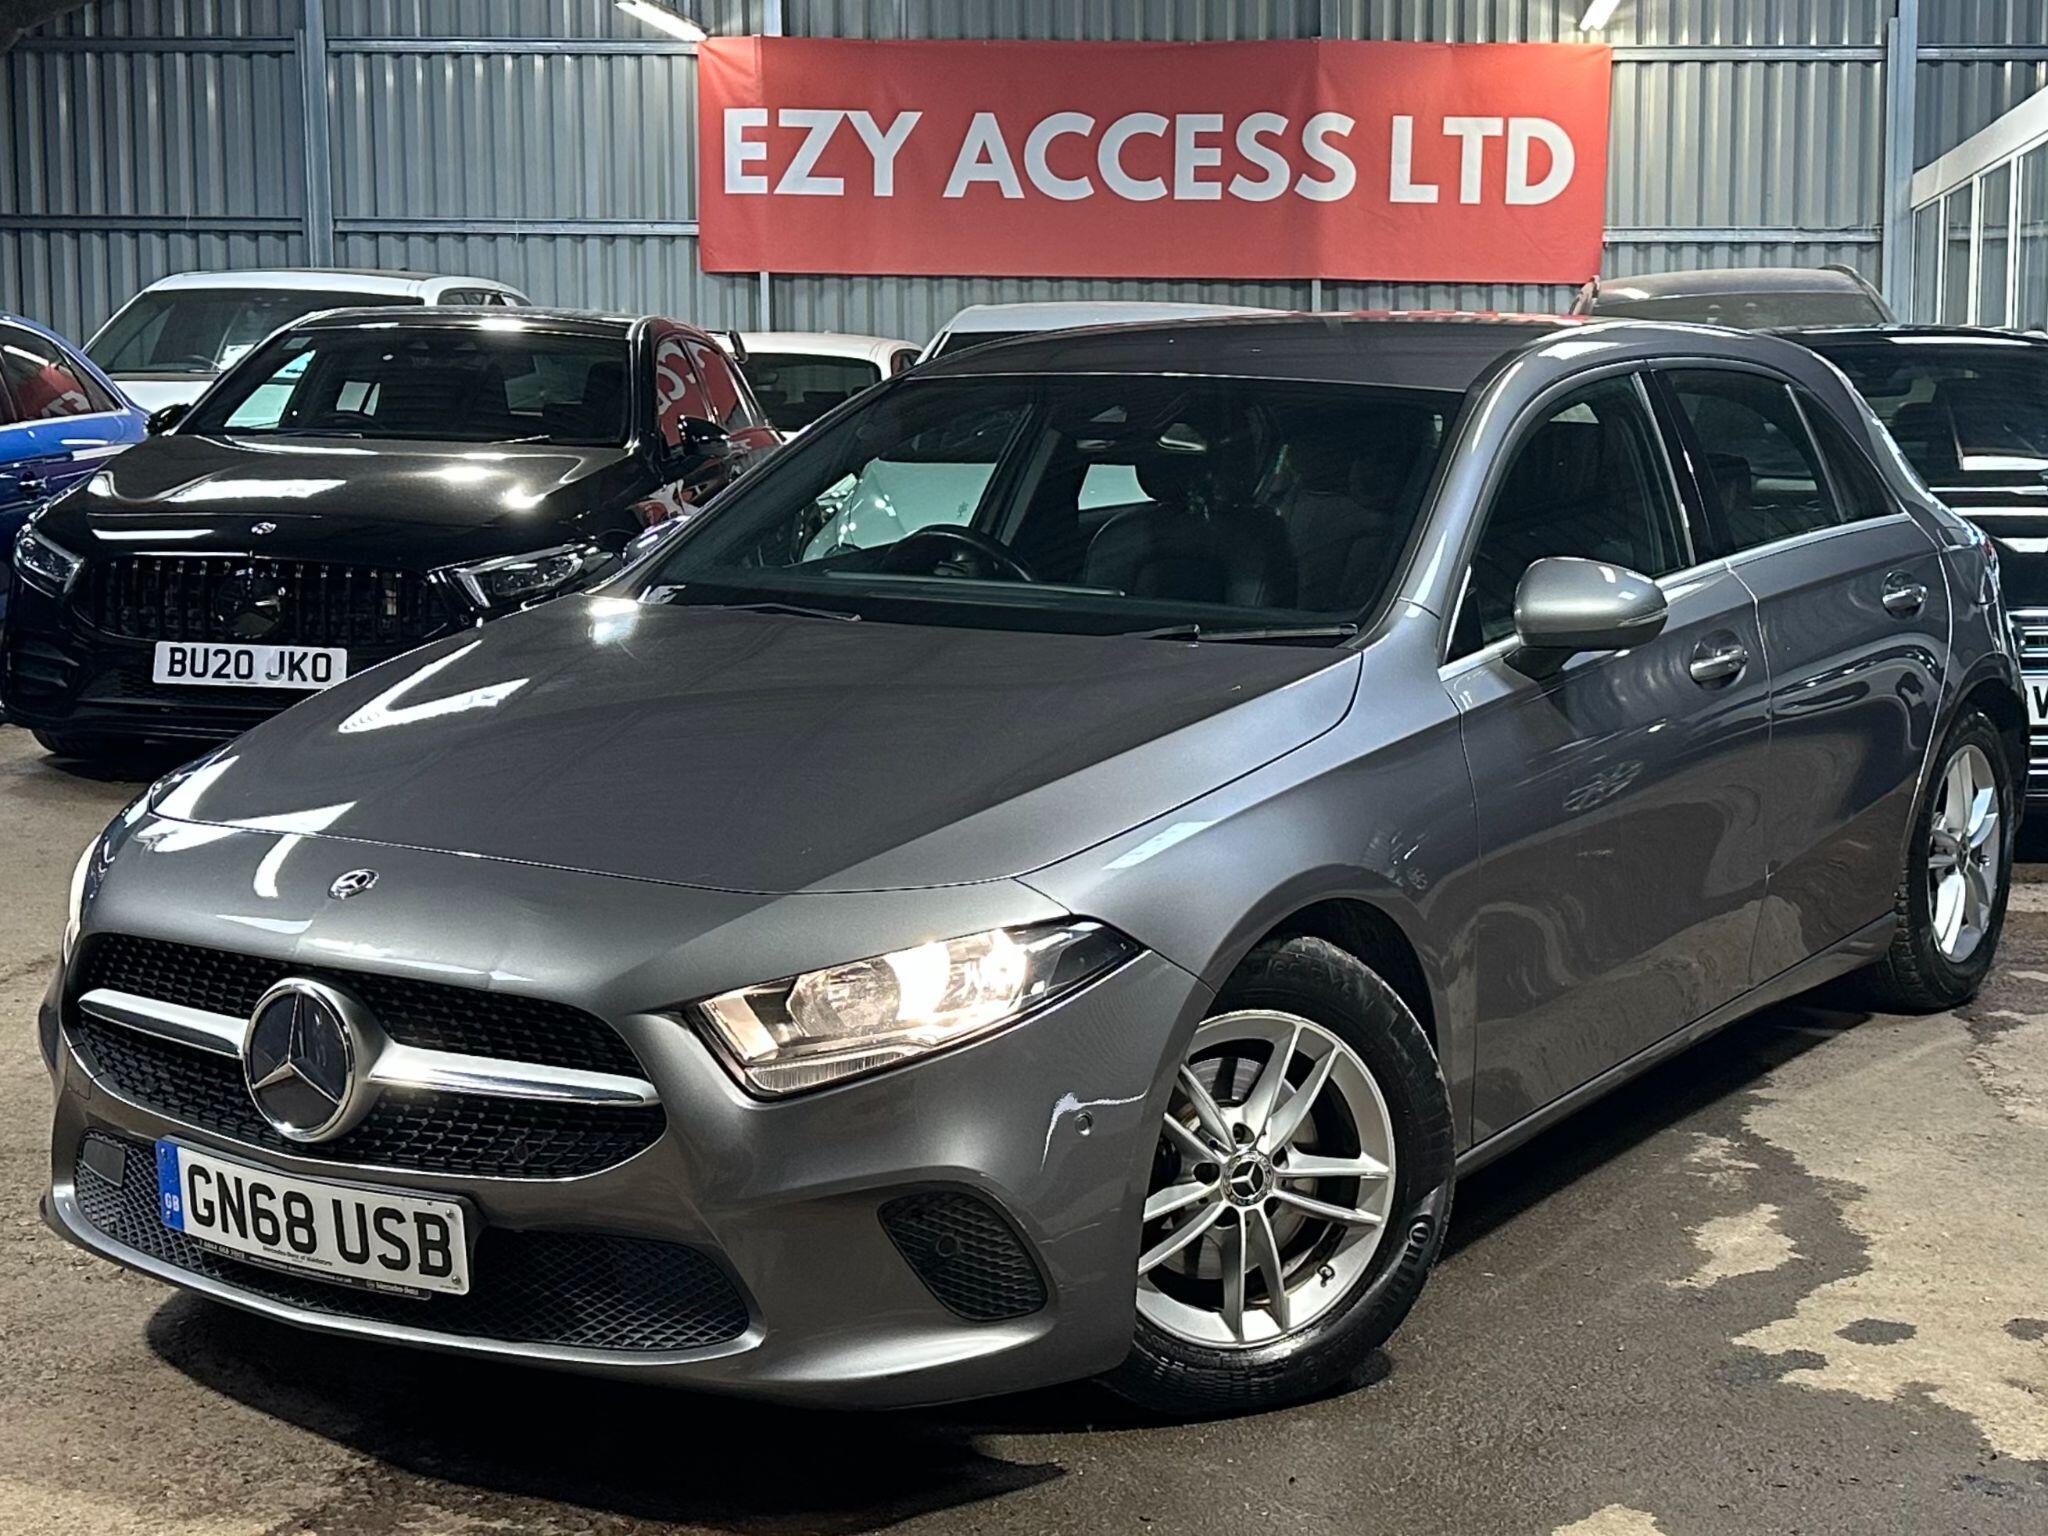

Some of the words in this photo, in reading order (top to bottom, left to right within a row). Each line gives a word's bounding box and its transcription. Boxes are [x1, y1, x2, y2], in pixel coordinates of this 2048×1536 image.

[723, 107, 922, 197] EZY
[942, 111, 1358, 202] ACCESS
[1389, 115, 1576, 206] LTD
[167, 646, 254, 680] BU20
[265, 650, 332, 683] JKO
[164, 1192, 180, 1212] GB
[187, 1163, 318, 1254] GN68
[332, 1198, 452, 1278] USB
